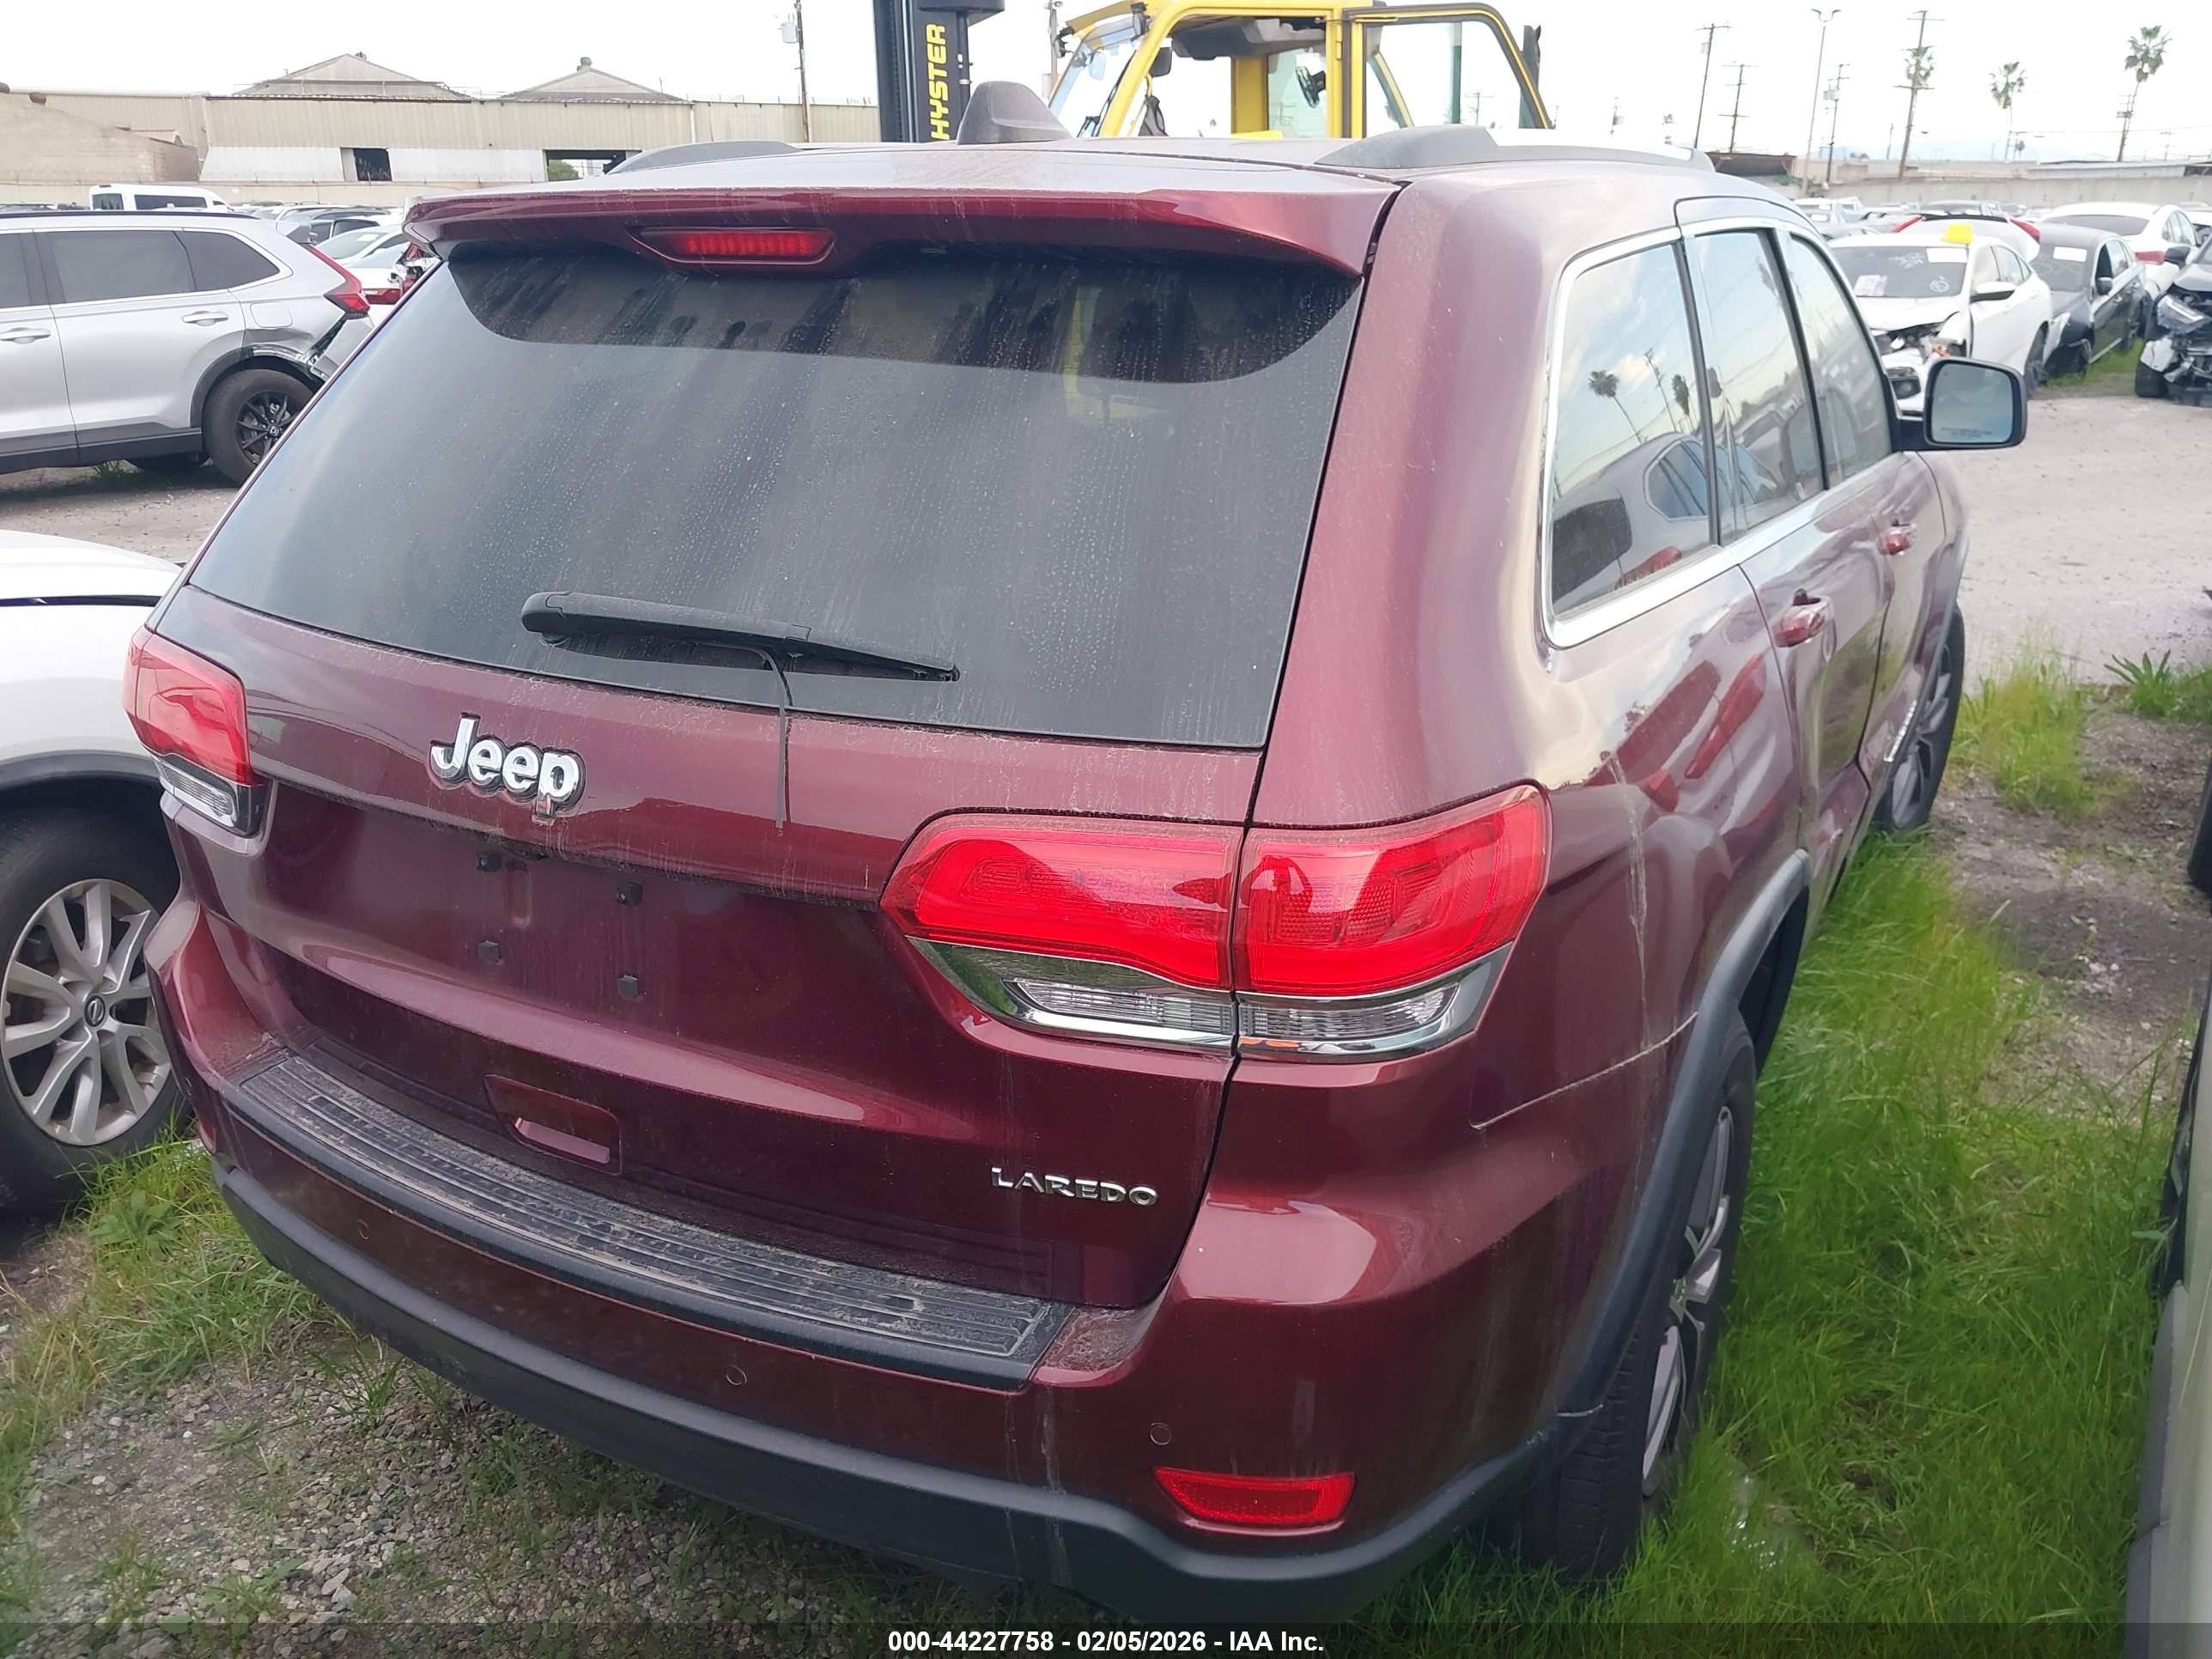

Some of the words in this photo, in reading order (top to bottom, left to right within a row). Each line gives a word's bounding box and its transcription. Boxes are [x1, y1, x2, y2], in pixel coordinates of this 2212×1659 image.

[926, 23, 951, 141] HYSTER
[430, 716, 584, 817] Jeep
[991, 1167, 1158, 1206] LAREDO
